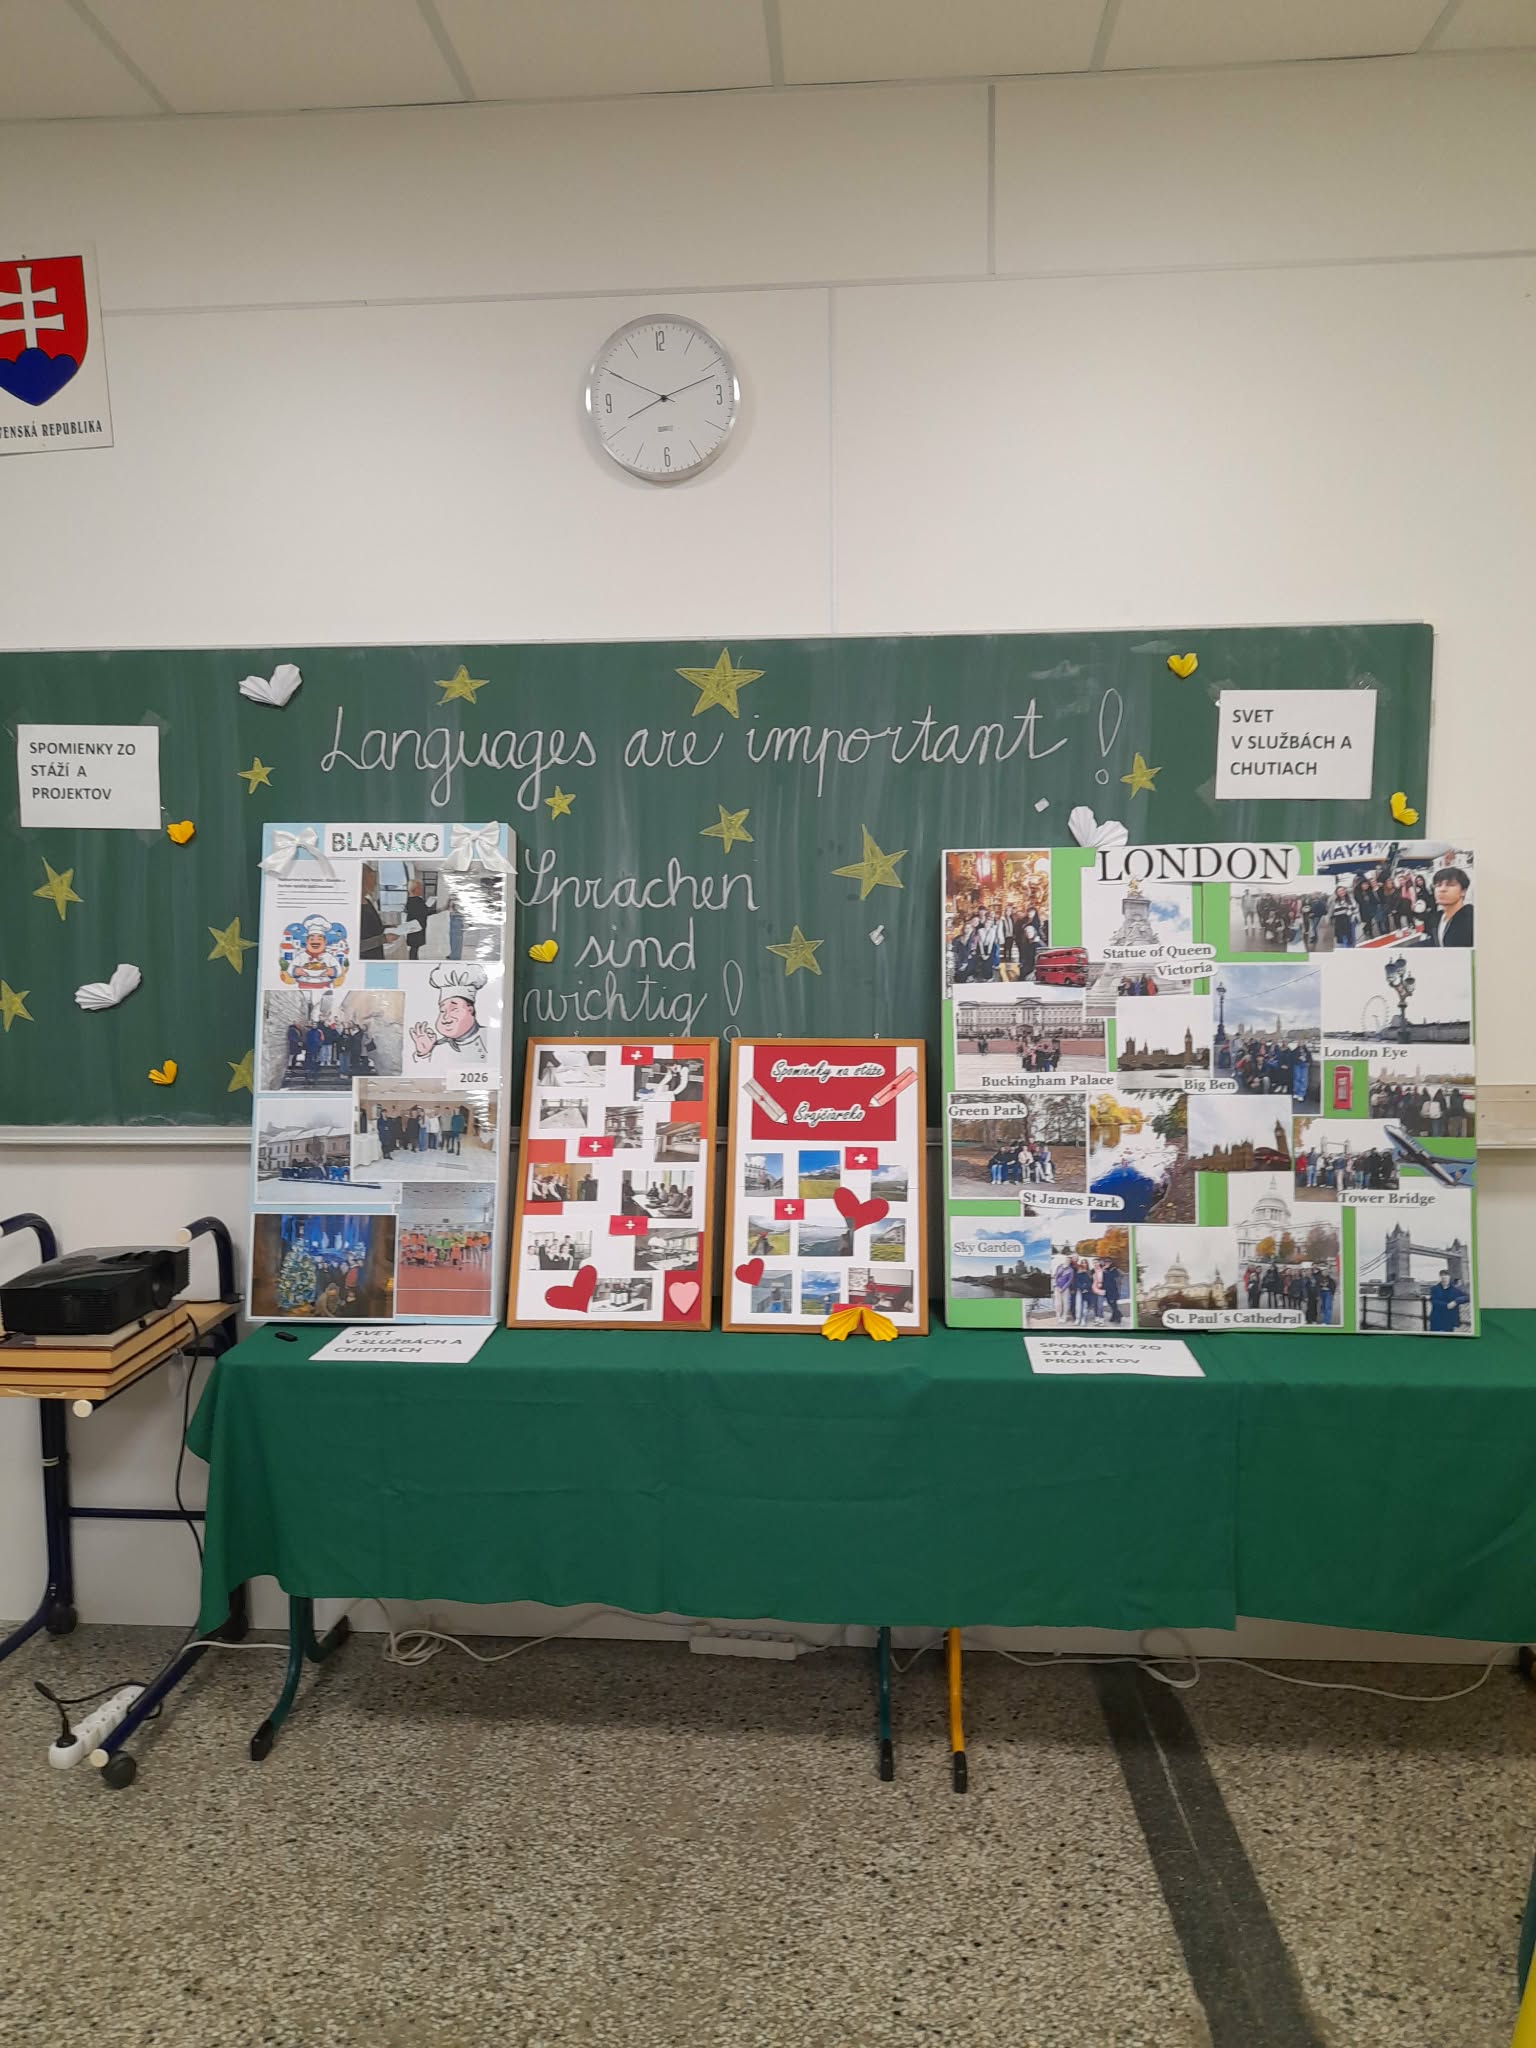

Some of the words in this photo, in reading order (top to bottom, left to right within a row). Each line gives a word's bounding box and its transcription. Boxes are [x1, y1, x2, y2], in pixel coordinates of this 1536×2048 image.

[655, 330, 665, 351] 12
[715, 384, 723, 405] 3
[605, 393, 613, 413] 9
[41, 420, 102, 437] REPUBLIKA
[663, 446, 671, 467] 6
[1232, 709, 1274, 723] SVET
[1231, 735, 1243, 749] V
[1247, 732, 1335, 749] SLUŽBÁCH
[1340, 736, 1352, 749] A
[29, 742, 113, 755] SPOMIENKY
[117, 743, 136, 755] ZO
[321, 706, 597, 811] Languages
[624, 728, 724, 768] are
[745, 697, 1068, 797] important
[31, 762, 70, 777] STÁŽÍ
[77, 765, 87, 777] A
[1230, 762, 1317, 775] CHUTIACH
[32, 787, 112, 800] PROJEKTOV
[331, 832, 440, 853] BLANSKO
[1099, 846, 1292, 881] LONDON
[515, 849, 760, 932] Sprachen
[574, 916, 696, 971] sind
[1103, 948, 1145, 960] Statue
[1150, 946, 1165, 959] of
[1166, 945, 1212, 959] Queen
[1157, 961, 1213, 976] Victoria
[1324, 1046, 1378, 1058] London
[1382, 1047, 1408, 1060] Eye
[460, 1072, 489, 1083] 2026
[772, 1061, 831, 1081] Spomienky
[836, 1068, 849, 1076] na
[981, 1075, 1066, 1089] Buckingham
[1070, 1075, 1114, 1086] Palace
[1184, 1079, 1206, 1092] Big
[1209, 1079, 1236, 1091] Ben
[948, 1105, 989, 1117] Green
[993, 1105, 1025, 1116] Park
[1023, 1192, 1037, 1204] St
[1039, 1193, 1083, 1206] James
[1086, 1196, 1120, 1209] Park
[1339, 1193, 1385, 1204] Tower
[1388, 1193, 1435, 1206] Bridge
[954, 1242, 975, 1254] Sky
[977, 1241, 1021, 1253] Garden
[1166, 1313, 1184, 1325] St.
[1233, 1312, 1301, 1325] Cathedral
[360, 1337, 446, 1345] SLUŽBÁCH
